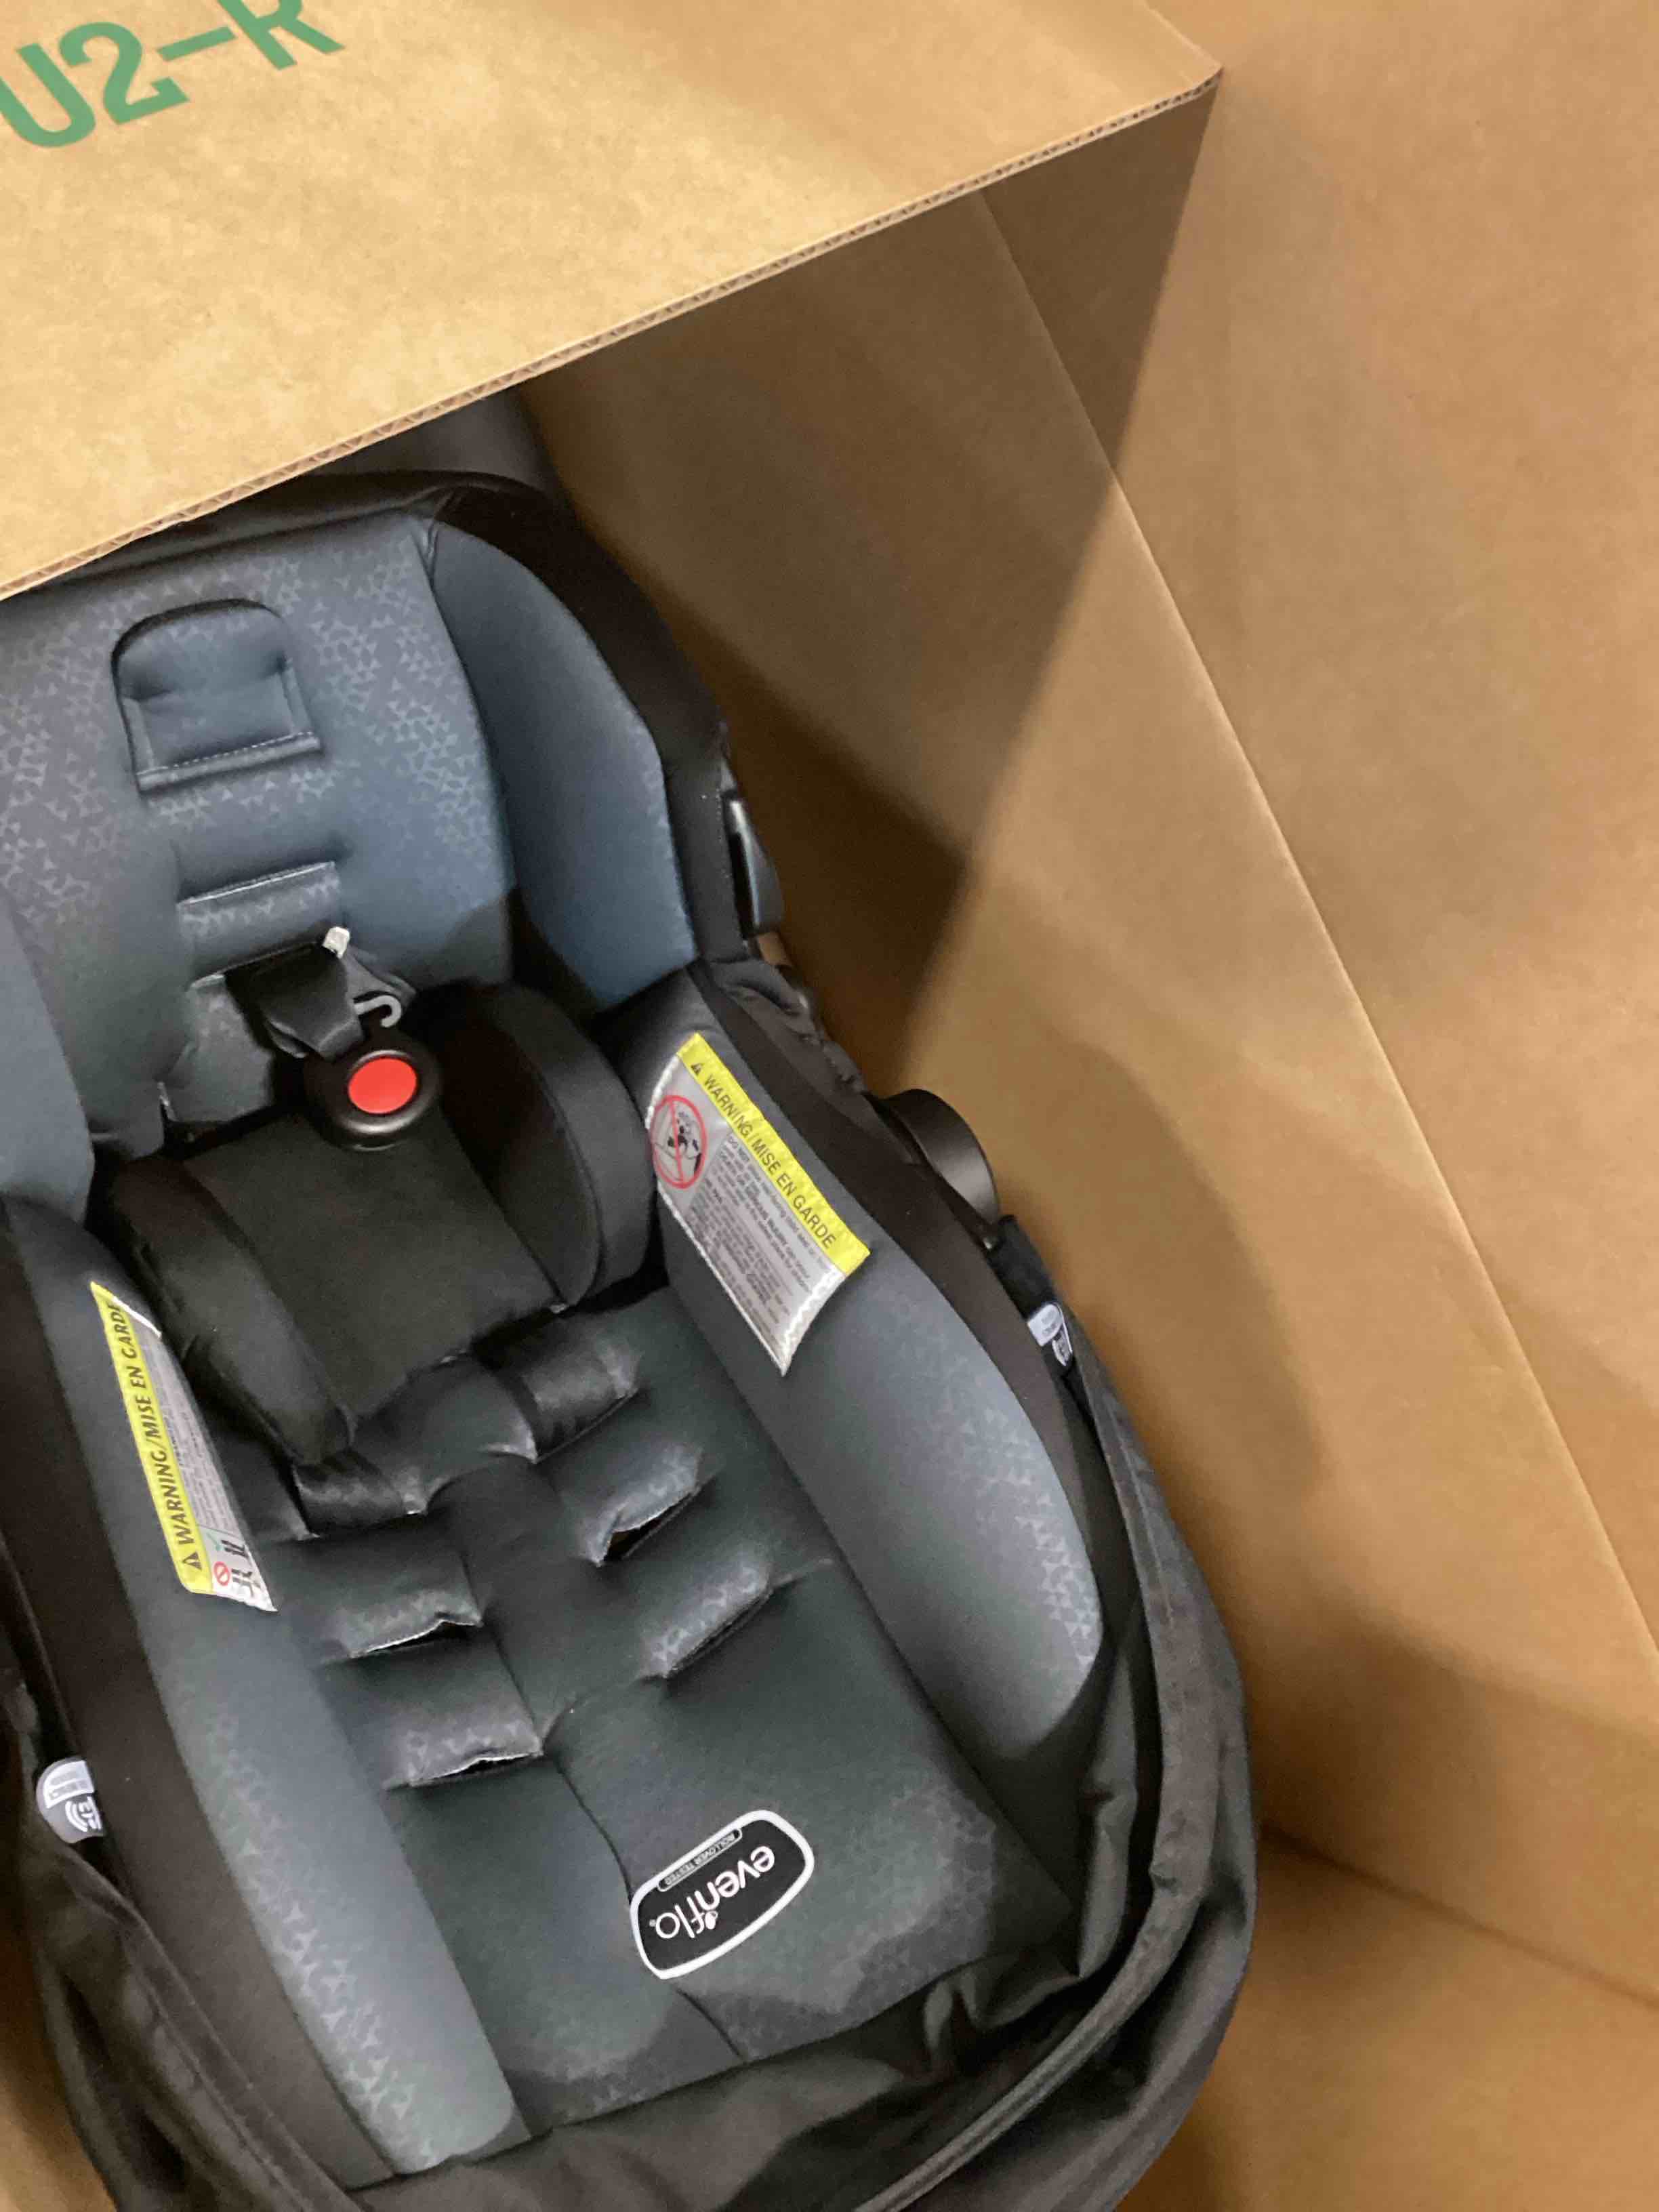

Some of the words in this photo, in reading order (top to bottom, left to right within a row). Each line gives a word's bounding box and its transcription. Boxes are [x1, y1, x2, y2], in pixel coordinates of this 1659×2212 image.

[777, 1173, 798, 1197] EN
[792, 1194, 836, 1249] GARDE
[131, 1365, 147, 1389] EN
[655, 1845, 775, 1939] evenflo
